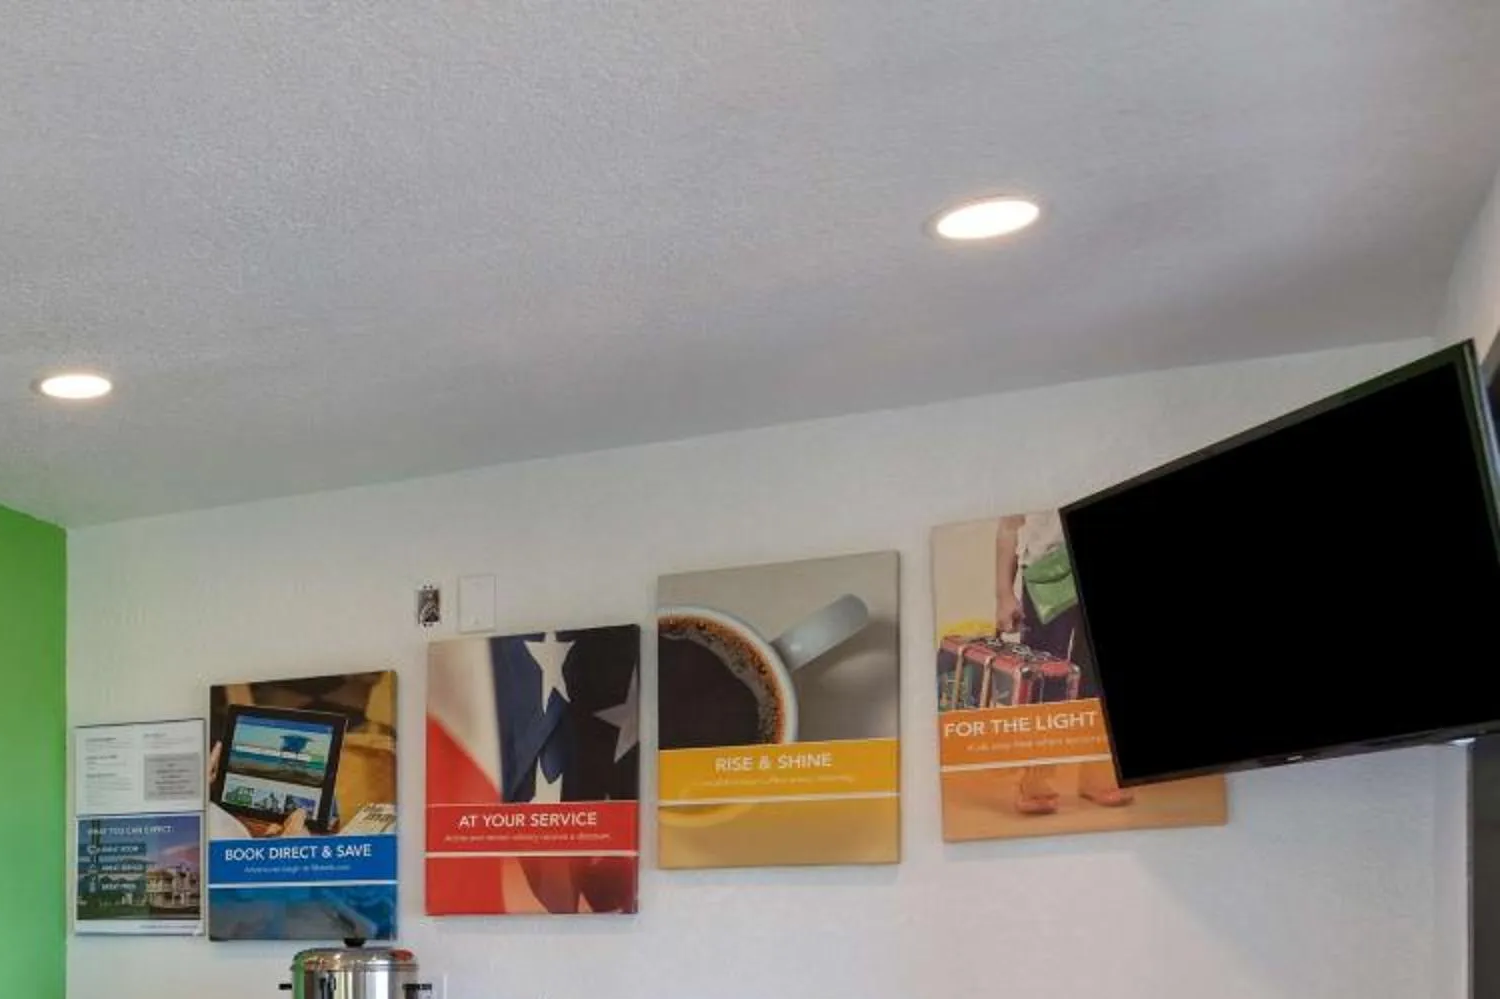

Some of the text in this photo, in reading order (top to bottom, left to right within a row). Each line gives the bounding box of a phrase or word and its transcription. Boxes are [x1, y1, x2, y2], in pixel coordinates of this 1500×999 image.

[944, 710, 1098, 737] FOR THE LIGHT
[715, 752, 832, 772] RISE & SHINE
[459, 811, 597, 828] AT YOUR SERVICE
[225, 843, 373, 861] BOOK DIRECT & SAVE
